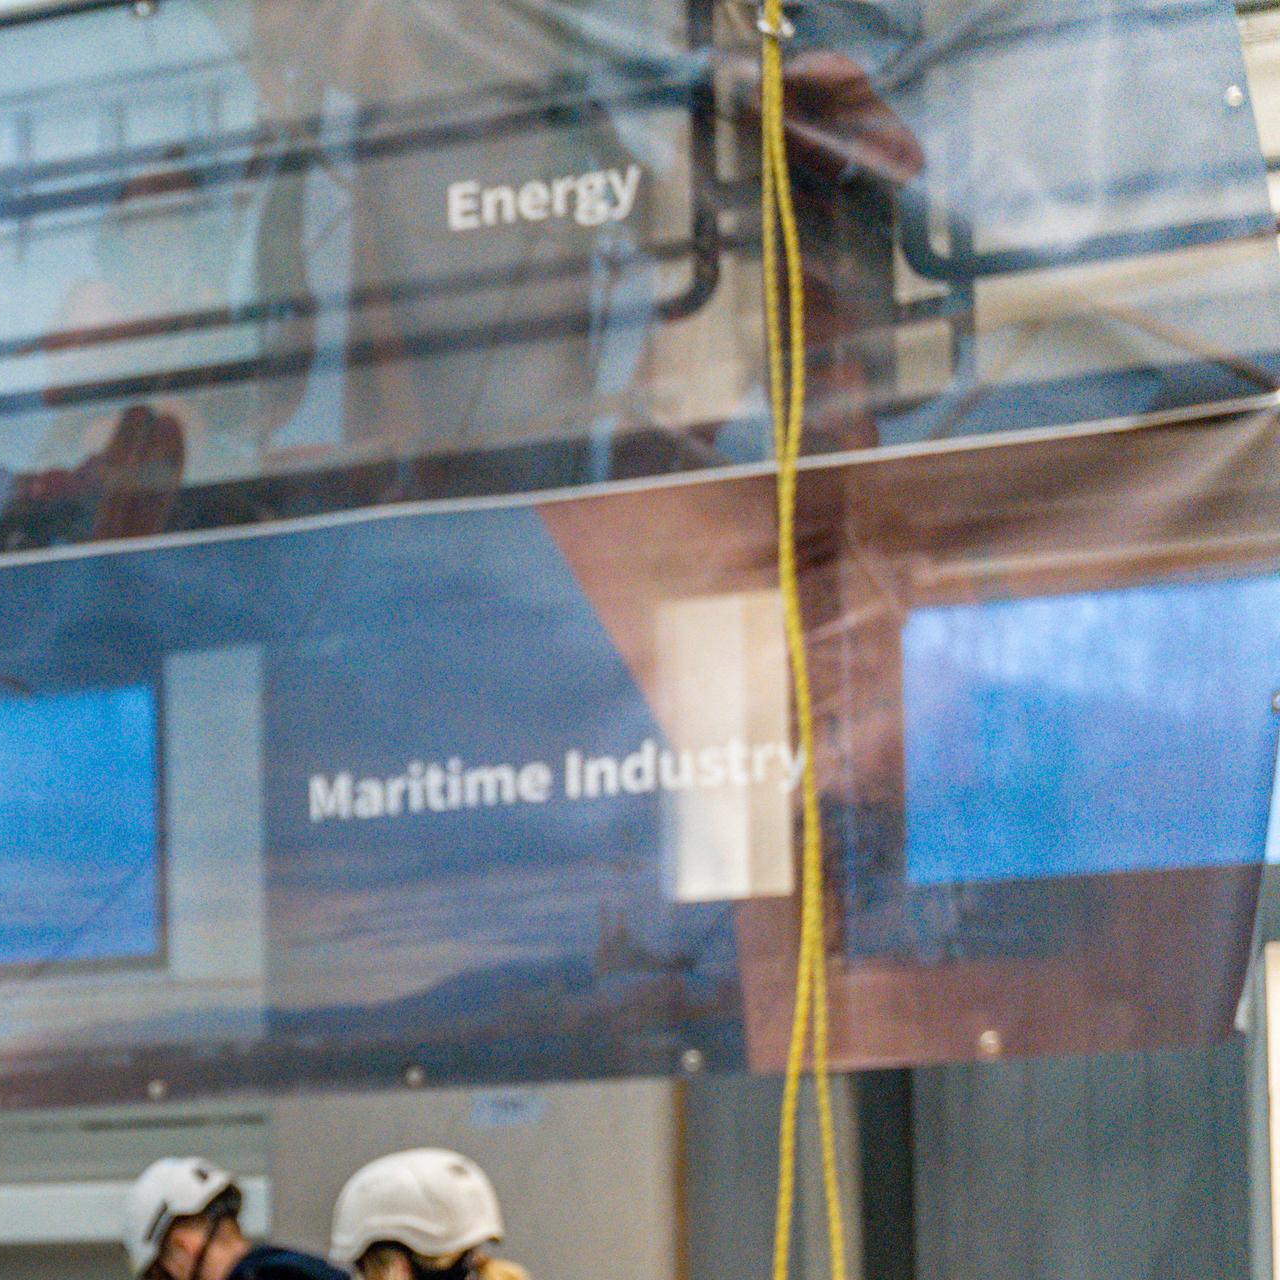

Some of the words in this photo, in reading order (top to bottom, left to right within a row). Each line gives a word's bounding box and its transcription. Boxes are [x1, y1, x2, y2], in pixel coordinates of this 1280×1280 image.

[447, 164, 640, 231] Energy
[307, 756, 553, 823] Maritime
[564, 737, 808, 800] Industry
